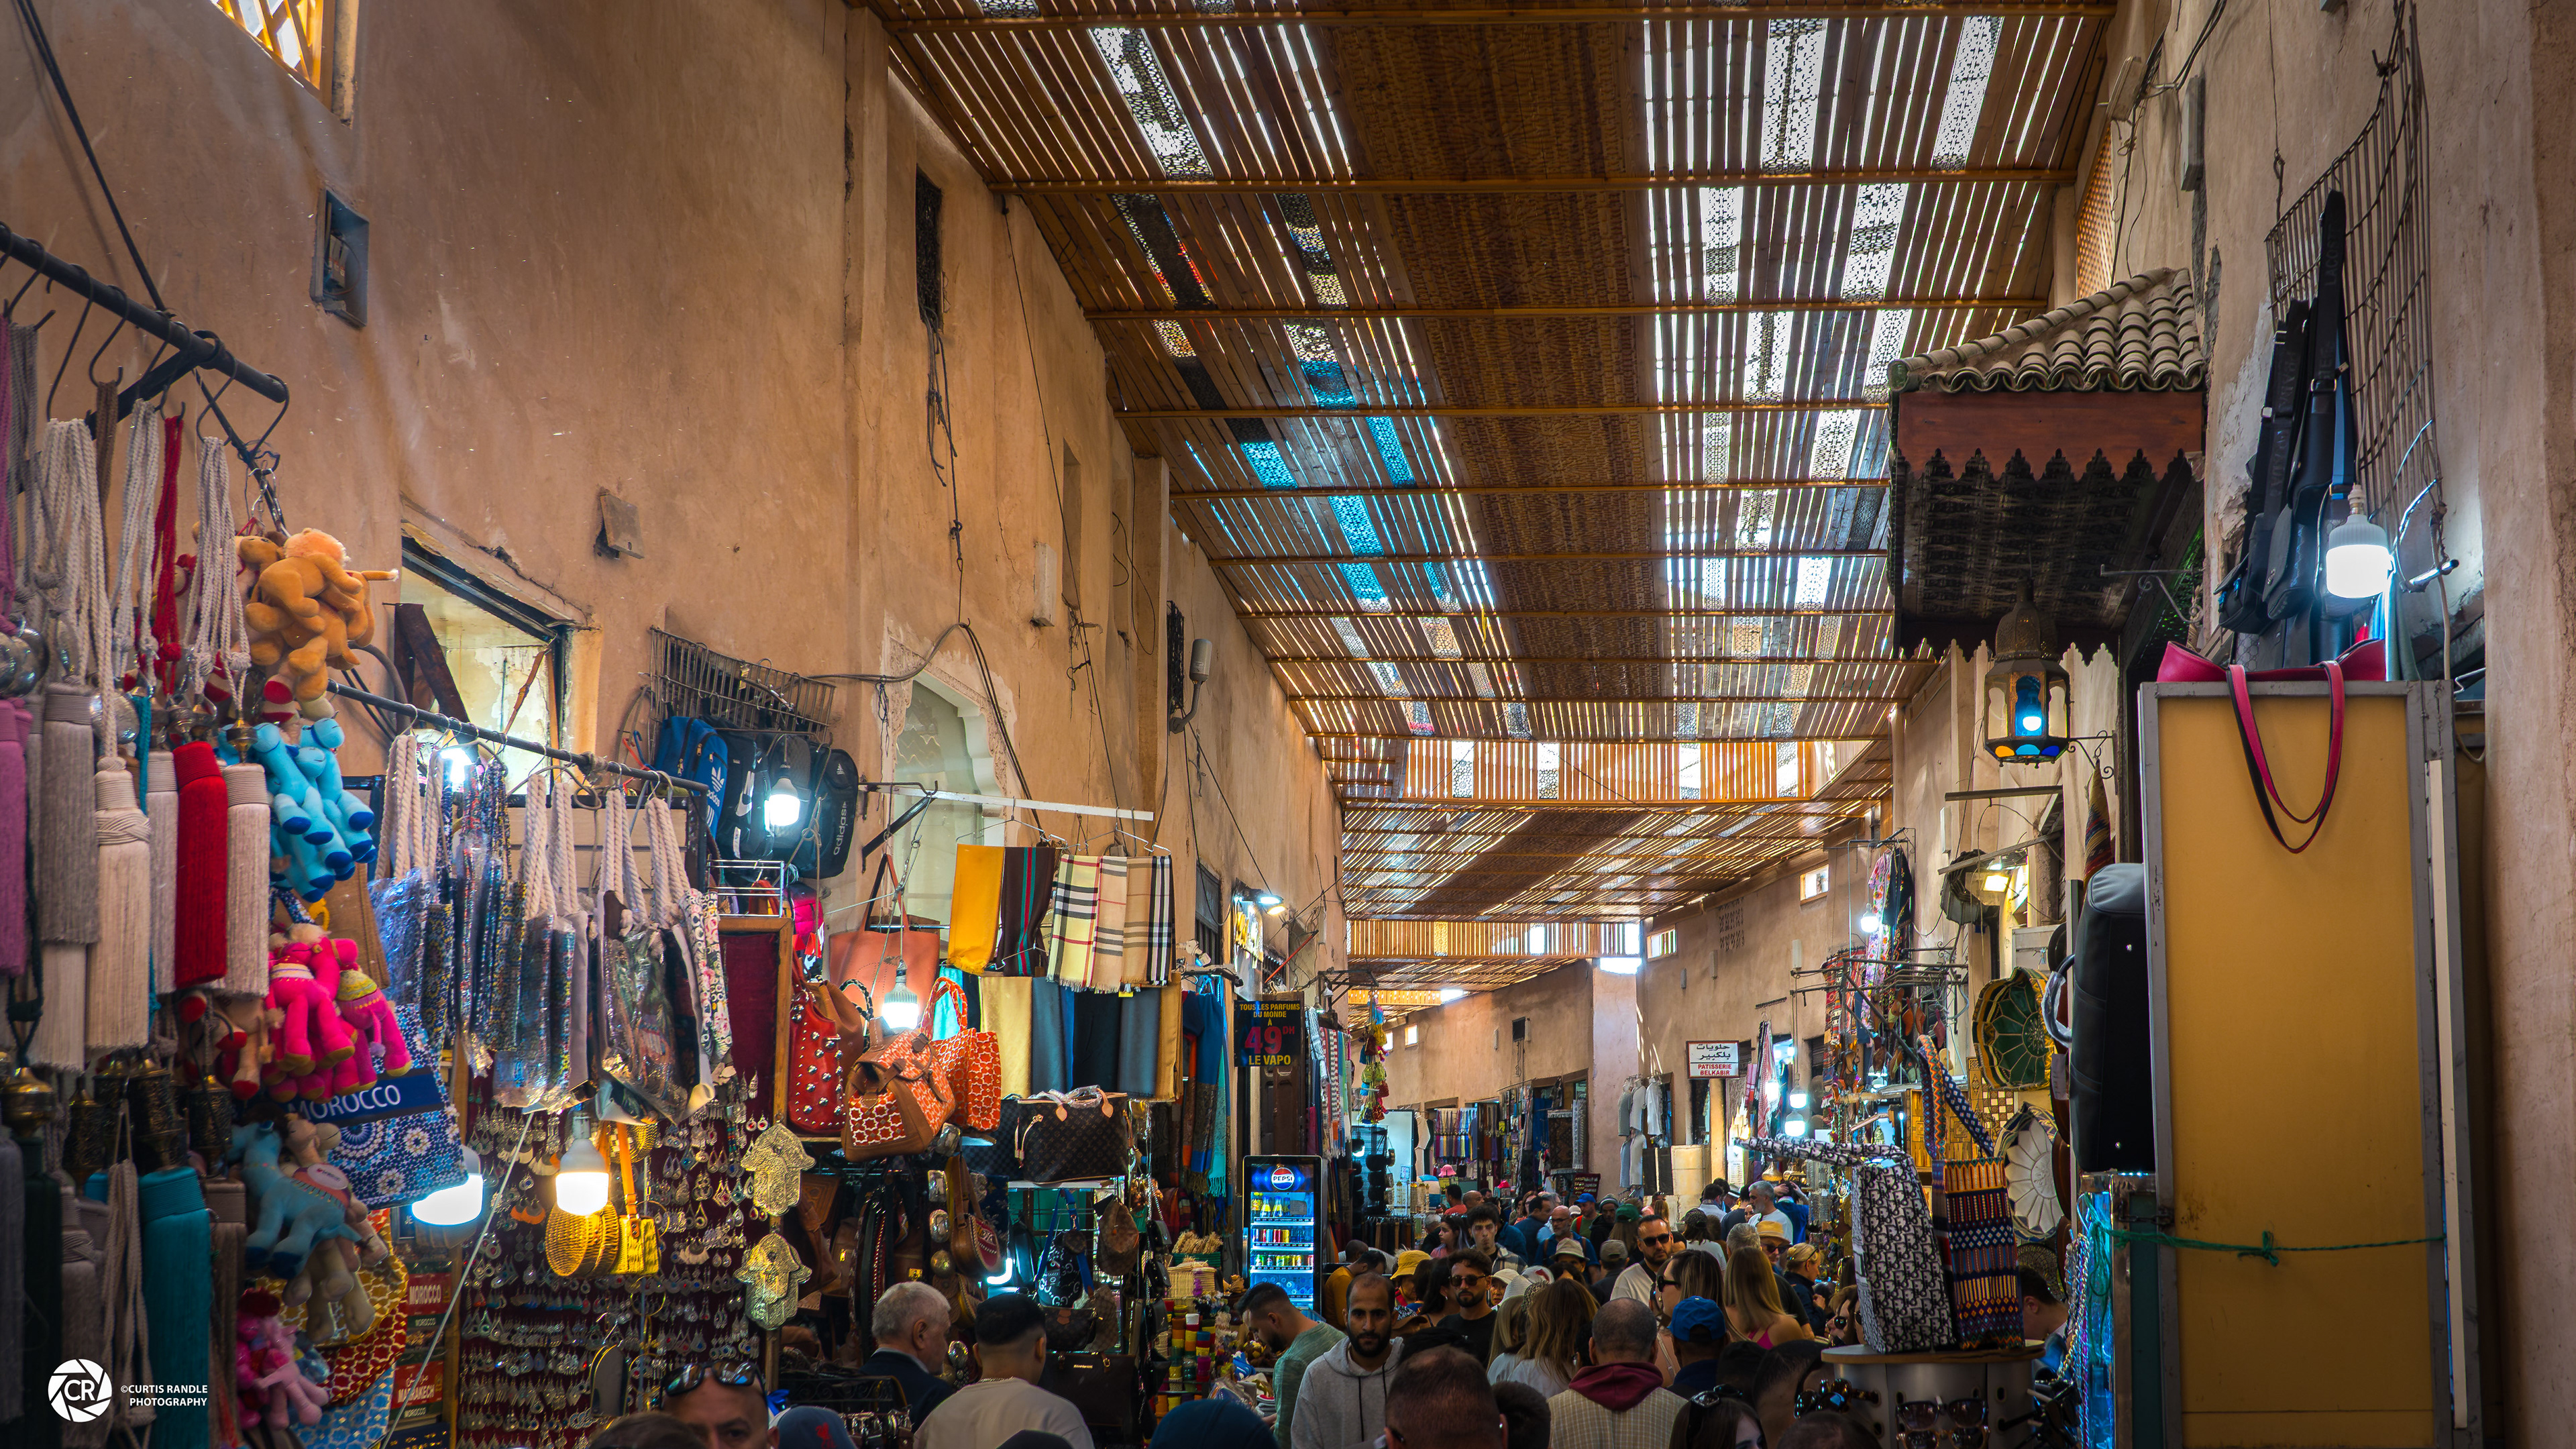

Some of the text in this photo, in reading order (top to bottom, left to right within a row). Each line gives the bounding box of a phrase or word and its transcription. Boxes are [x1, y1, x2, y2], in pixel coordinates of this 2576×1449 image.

[833, 808, 847, 855] adidas
[1244, 1026, 1295, 1055] 49 DH
[1248, 1055, 1291, 1065] LE VAPO
[1699, 1051, 1731, 1061] بلكبير
[409, 1284, 442, 1305] MOROCCO
[415, 1318, 436, 1327] MOROCCO
[404, 1407, 427, 1418] MOROCCO
